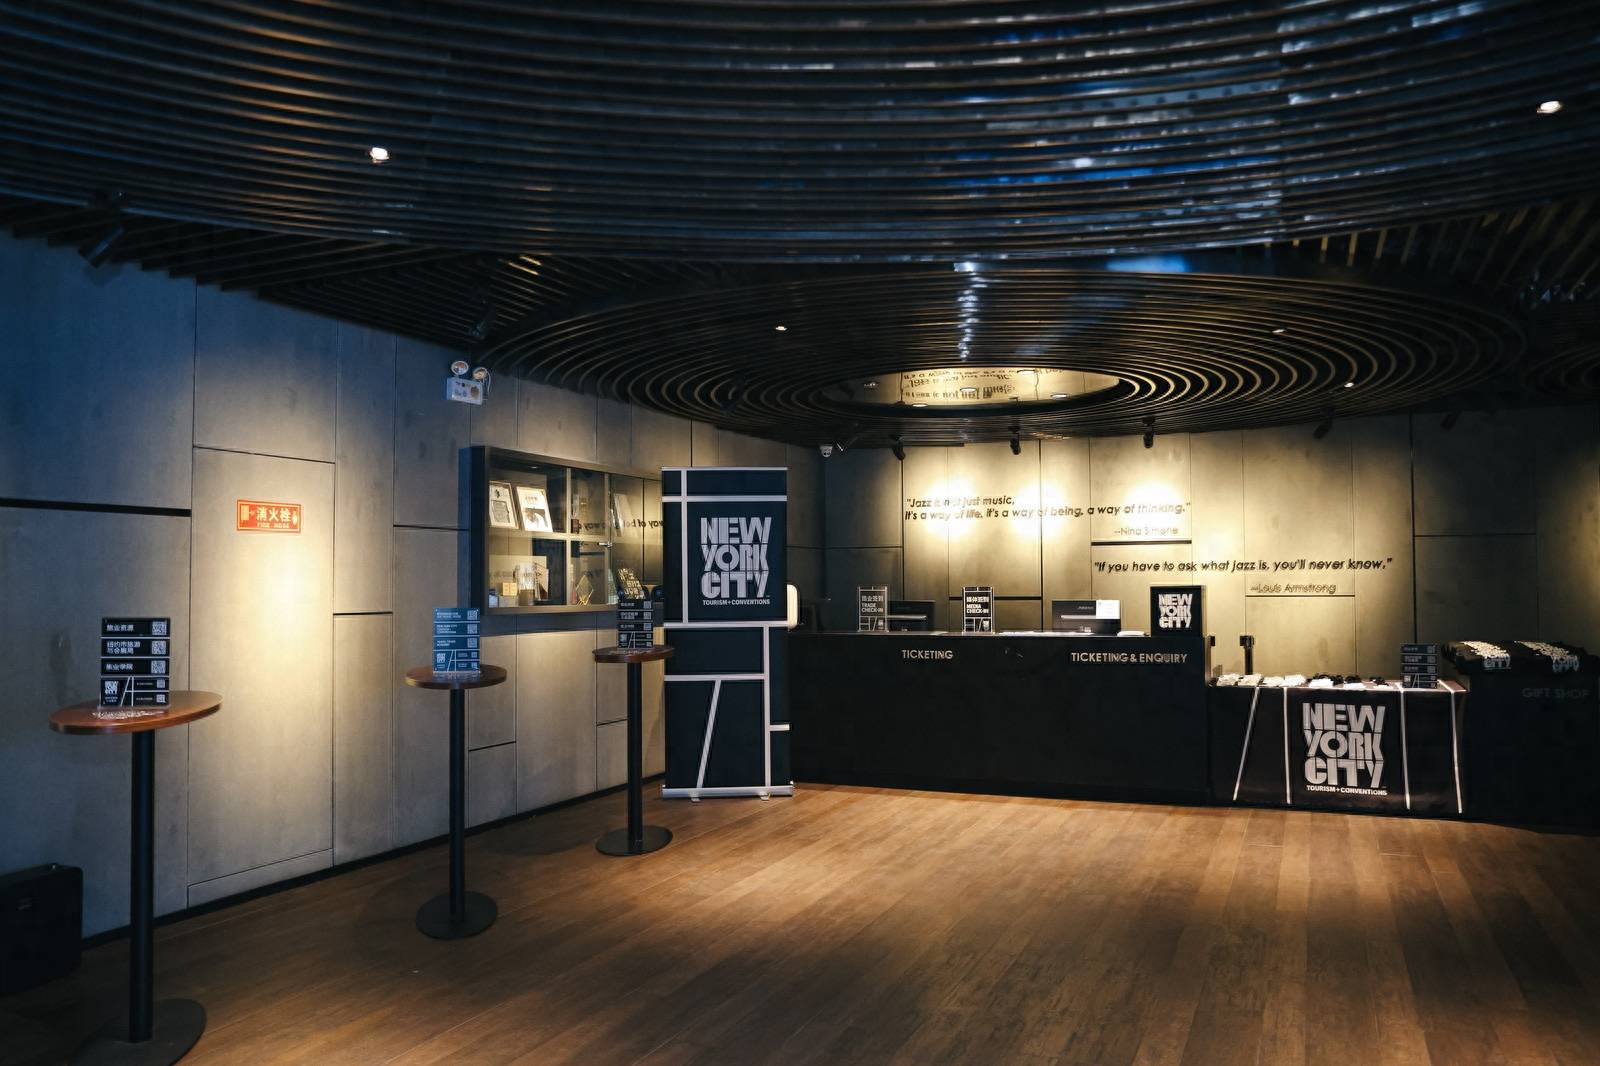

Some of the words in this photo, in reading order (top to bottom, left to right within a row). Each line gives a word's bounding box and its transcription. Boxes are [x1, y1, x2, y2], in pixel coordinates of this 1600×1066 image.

[256, 506, 292, 521] 消火栓
[920, 512, 927, 520] a
[930, 511, 951, 522] way
[954, 509, 964, 519] of
[1001, 508, 1009, 517] a
[1012, 507, 1034, 518] way
[1038, 507, 1049, 518] of
[1087, 507, 1095, 515] a
[1097, 506, 1120, 515] way
[1123, 503, 1135, 514] of
[700, 517, 772, 544] NEW
[701, 544, 769, 572] YORK
[1107, 563, 1129, 573] you
[1132, 561, 1160, 572] have
[1163, 561, 1175, 571] to
[1177, 560, 1197, 571] ask
[1201, 560, 1230, 571] what
[1231, 560, 1256, 573] jazz
[1274, 559, 1306, 572] you'll
[1308, 561, 1345, 570] never
[701, 571, 769, 599] CITY
[1284, 583, 1337, 594] Armstrong
[1158, 593, 1193, 605] NEW
[1160, 605, 1192, 617] YORK
[1158, 616, 1192, 628] CITY
[902, 650, 953, 660] TICKETING
[1071, 652, 1128, 663] TICKETING
[1129, 653, 1137, 663] &
[1139, 653, 1188, 664] ENQUIRY
[1521, 687, 1550, 698] GIFT
[1302, 702, 1386, 733] NEW
[1304, 730, 1384, 761] YORK
[1304, 757, 1384, 788] CITY
